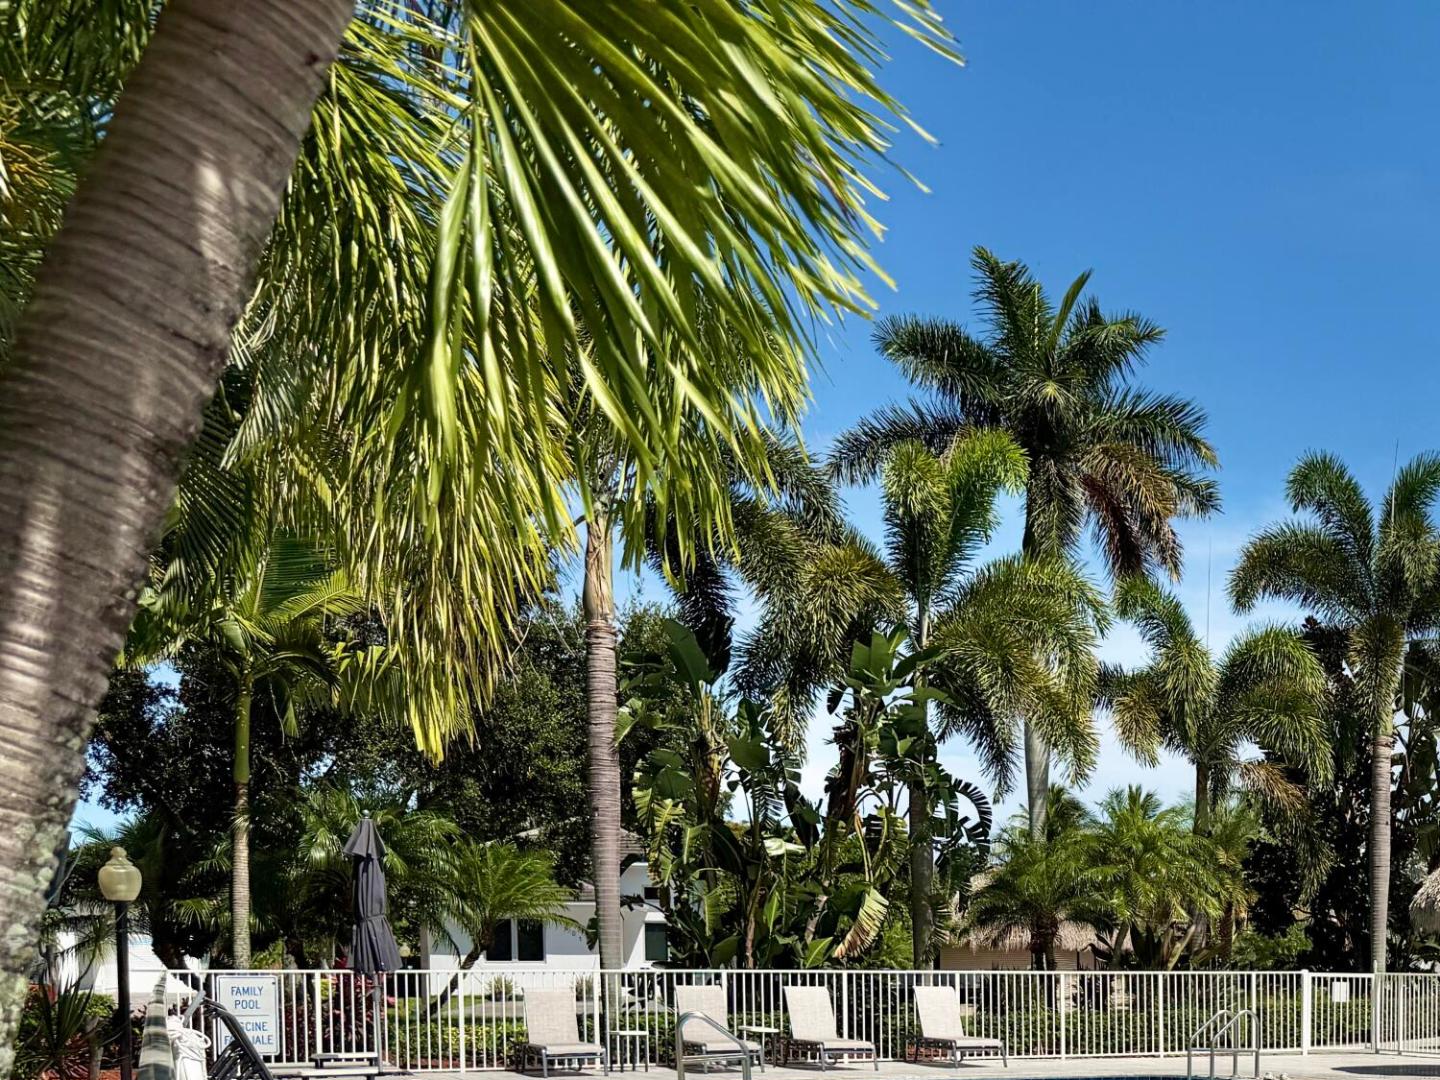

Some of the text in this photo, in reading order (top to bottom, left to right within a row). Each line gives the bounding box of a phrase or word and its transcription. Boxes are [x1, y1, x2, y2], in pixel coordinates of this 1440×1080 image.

[231, 986, 264, 996] FAMILY
[235, 1000, 261, 1009] POOL
[240, 1021, 268, 1032] CINE
